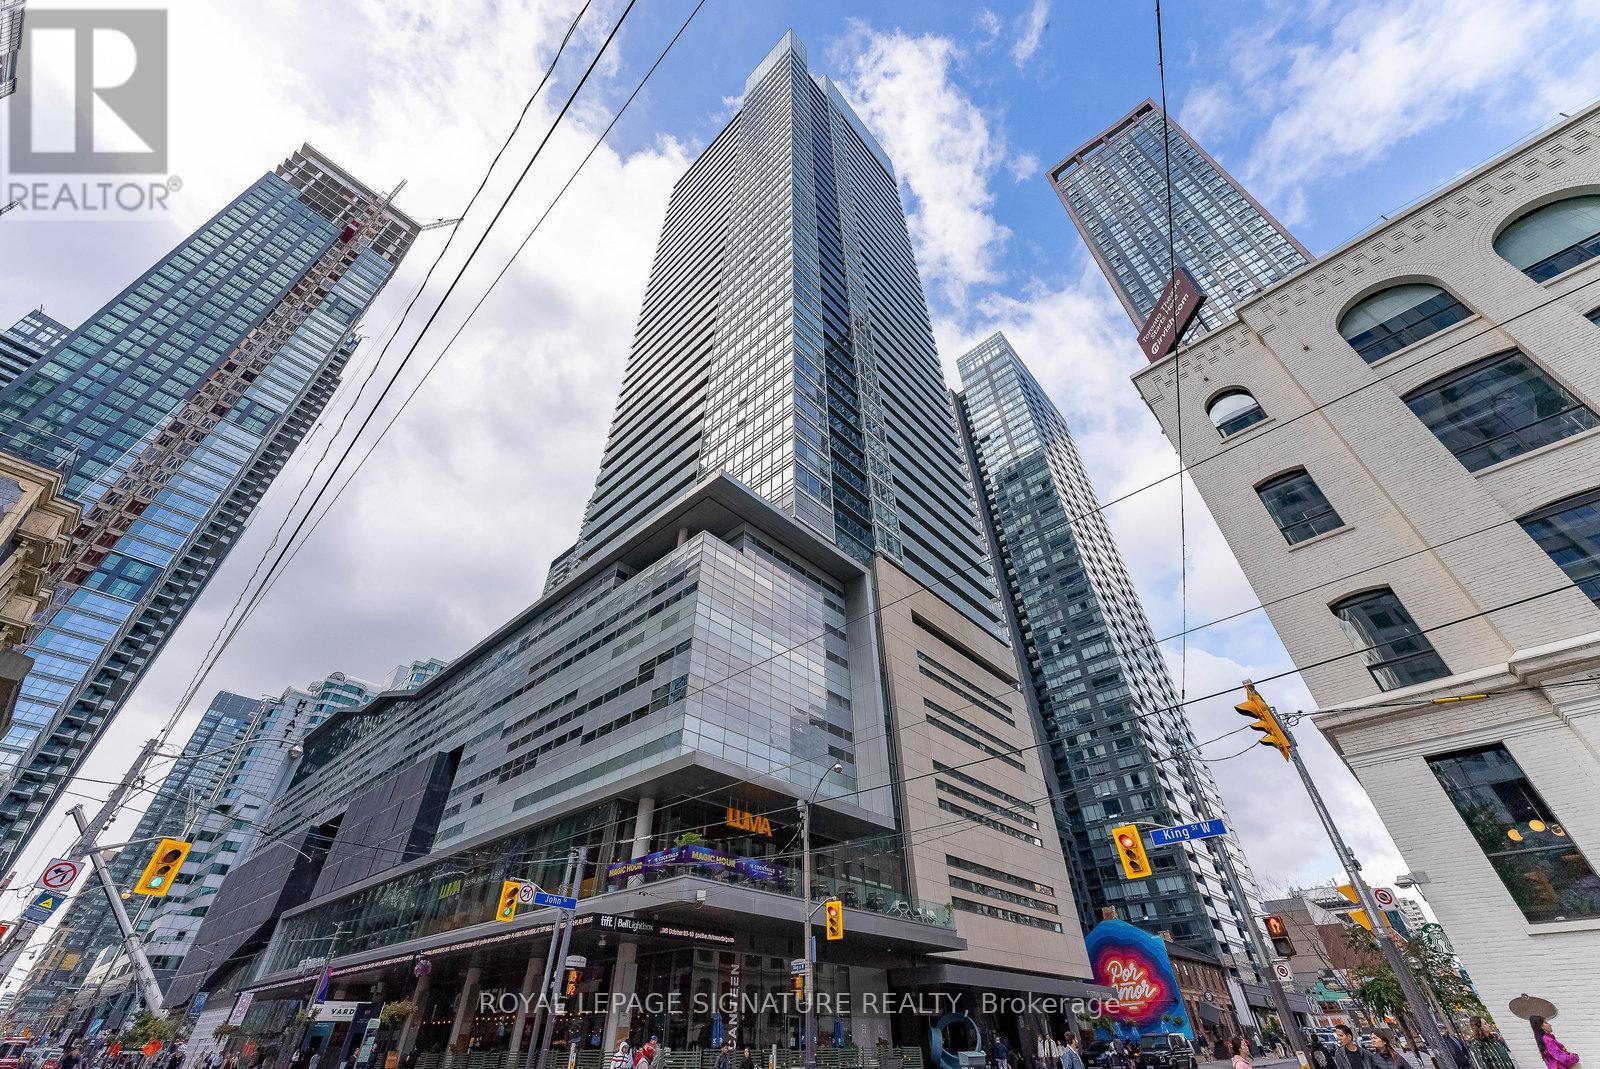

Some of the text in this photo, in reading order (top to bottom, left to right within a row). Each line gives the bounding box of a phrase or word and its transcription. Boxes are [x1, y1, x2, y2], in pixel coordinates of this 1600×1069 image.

[1142, 313, 1162, 342] Toronto
[1150, 315, 1167, 340] Starts
[726, 807, 772, 837] LUMA
[1163, 828, 1190, 840] King
[1200, 822, 1211, 834] W
[608, 865, 627, 877] MAGIC
[626, 861, 643, 873] HOUR
[691, 850, 716, 864] MAGIC
[715, 856, 736, 868] HOUR
[545, 894, 562, 905] John
[1107, 960, 1144, 983] Por
[728, 964, 740, 1050] CANTEEN
